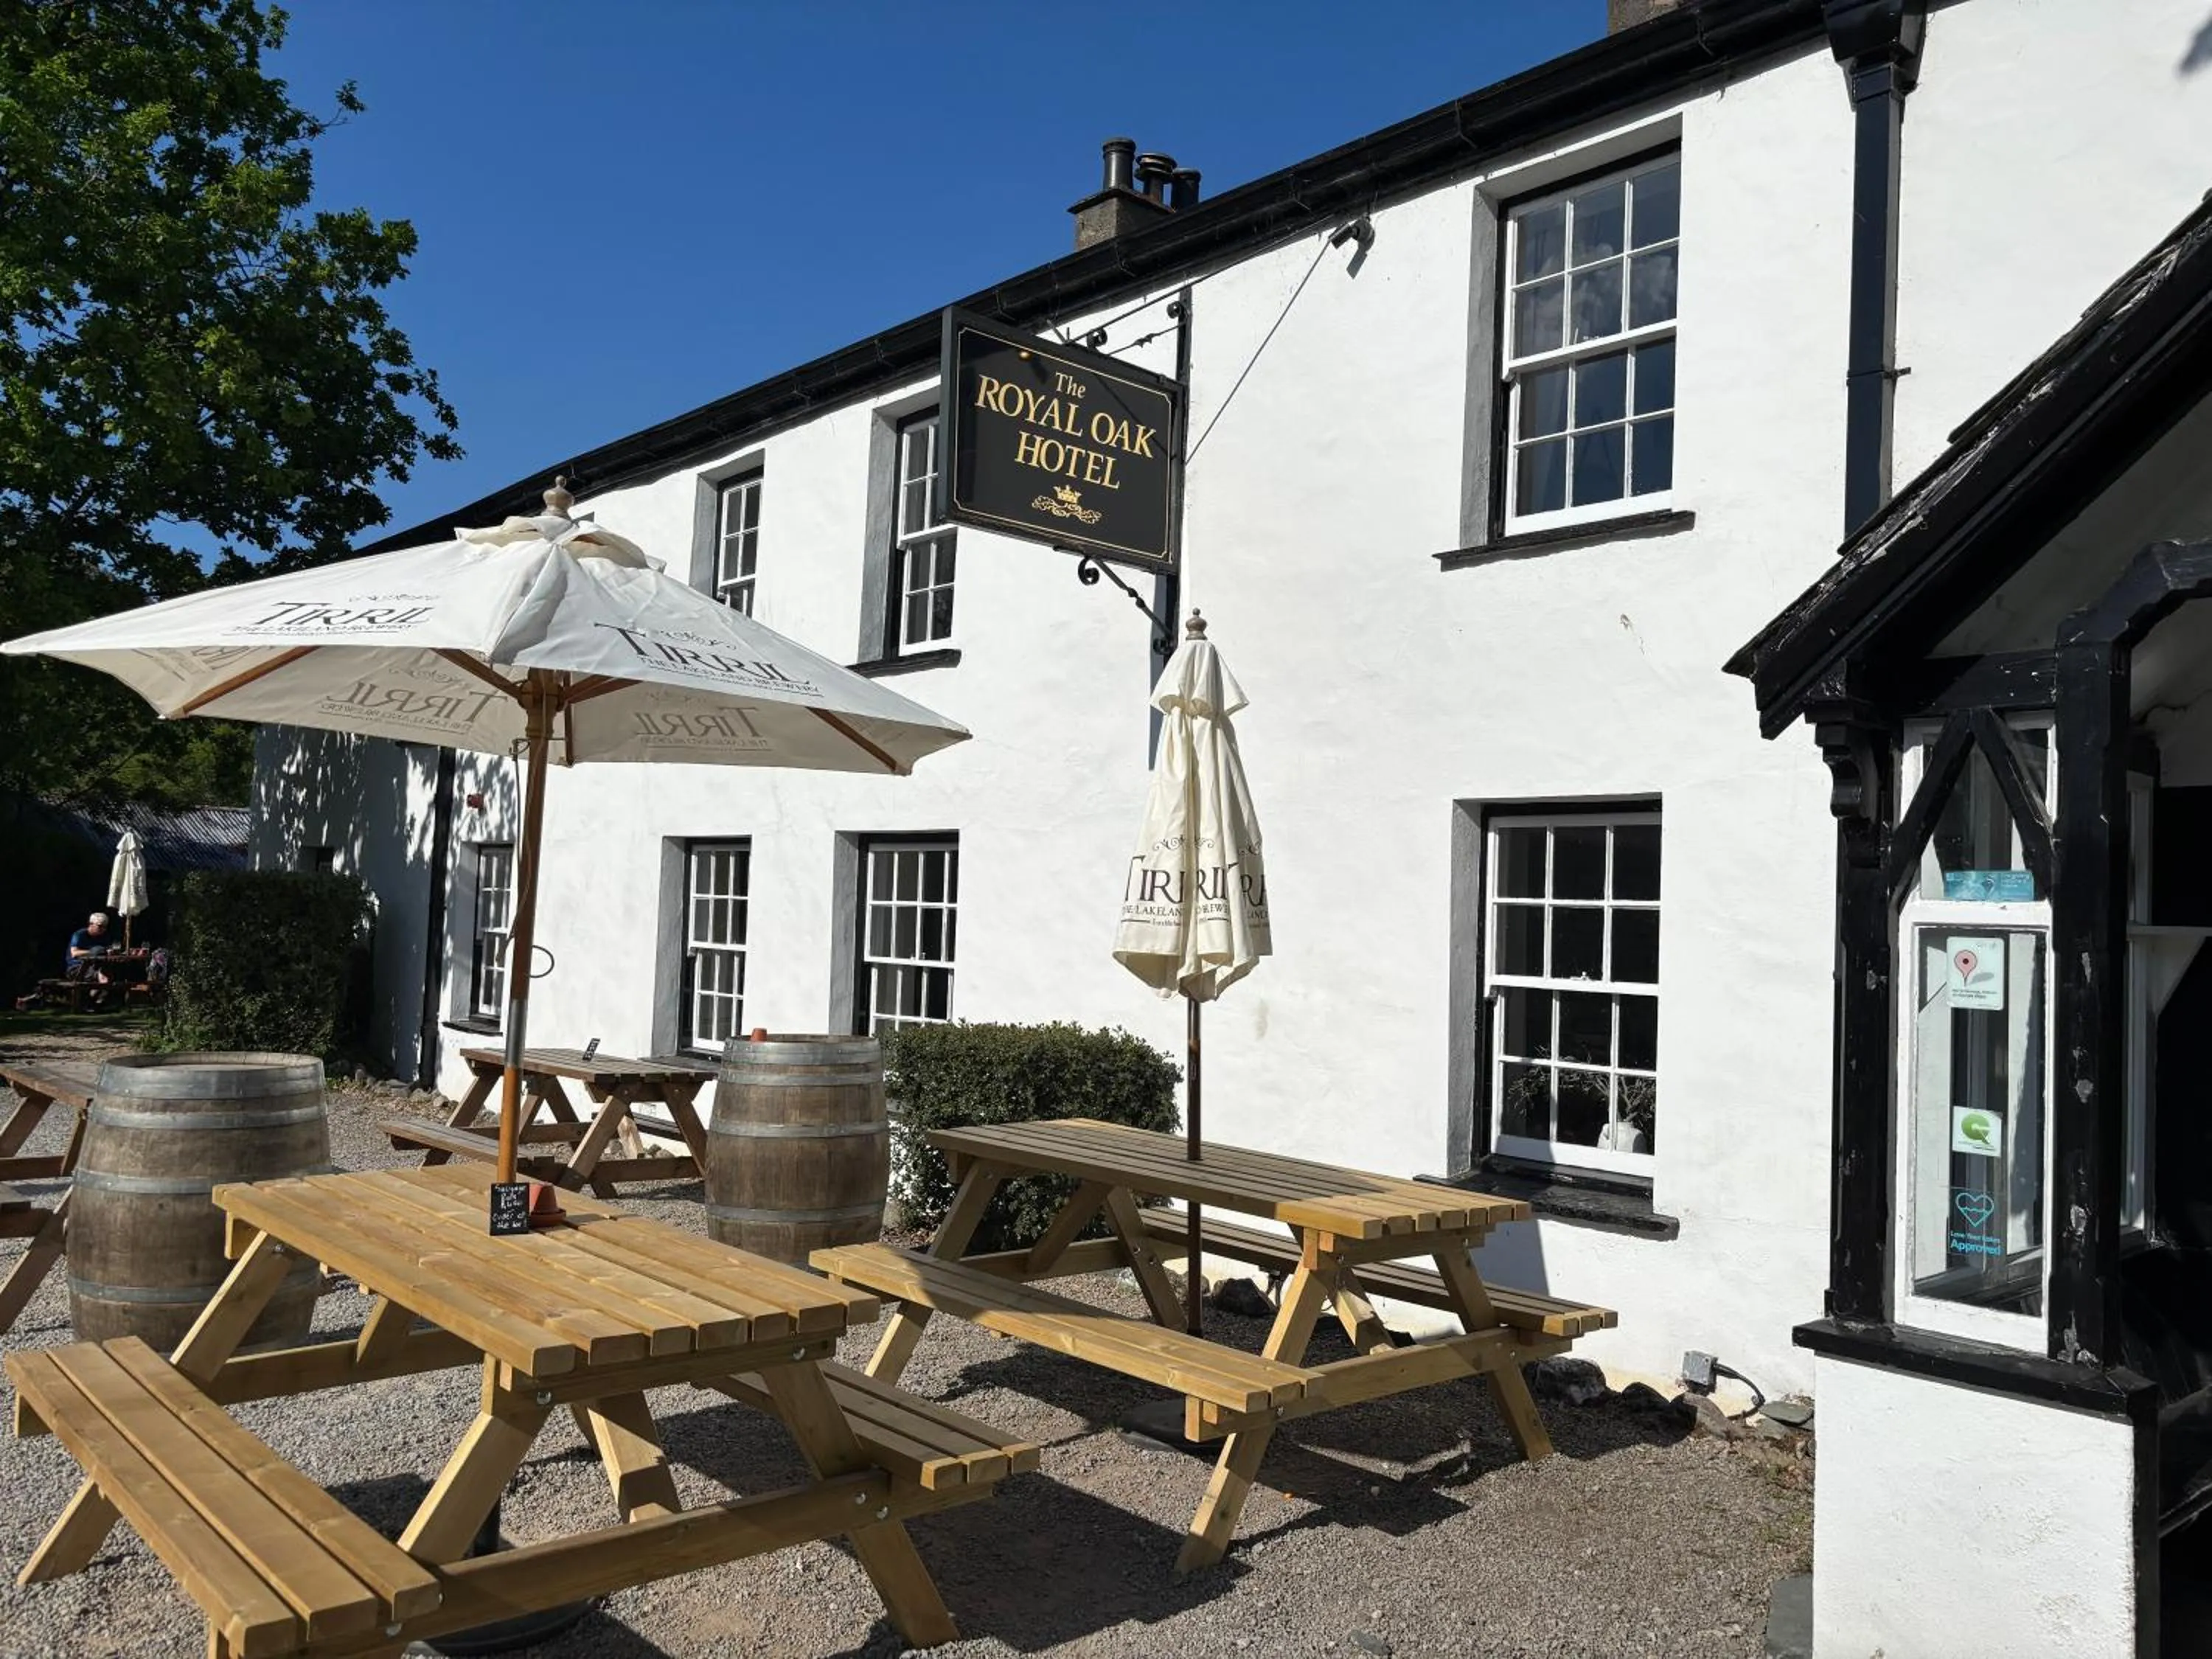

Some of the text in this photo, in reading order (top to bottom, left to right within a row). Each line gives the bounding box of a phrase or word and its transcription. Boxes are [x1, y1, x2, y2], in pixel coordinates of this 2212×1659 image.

[1056, 372, 1086, 398] The
[975, 374, 1156, 459] ROYAL OAK
[1015, 431, 1120, 489] HOTEL
[254, 601, 434, 626] TIRRIL
[594, 622, 811, 685] TIRRIL
[1950, 1238, 2002, 1255] Approved
